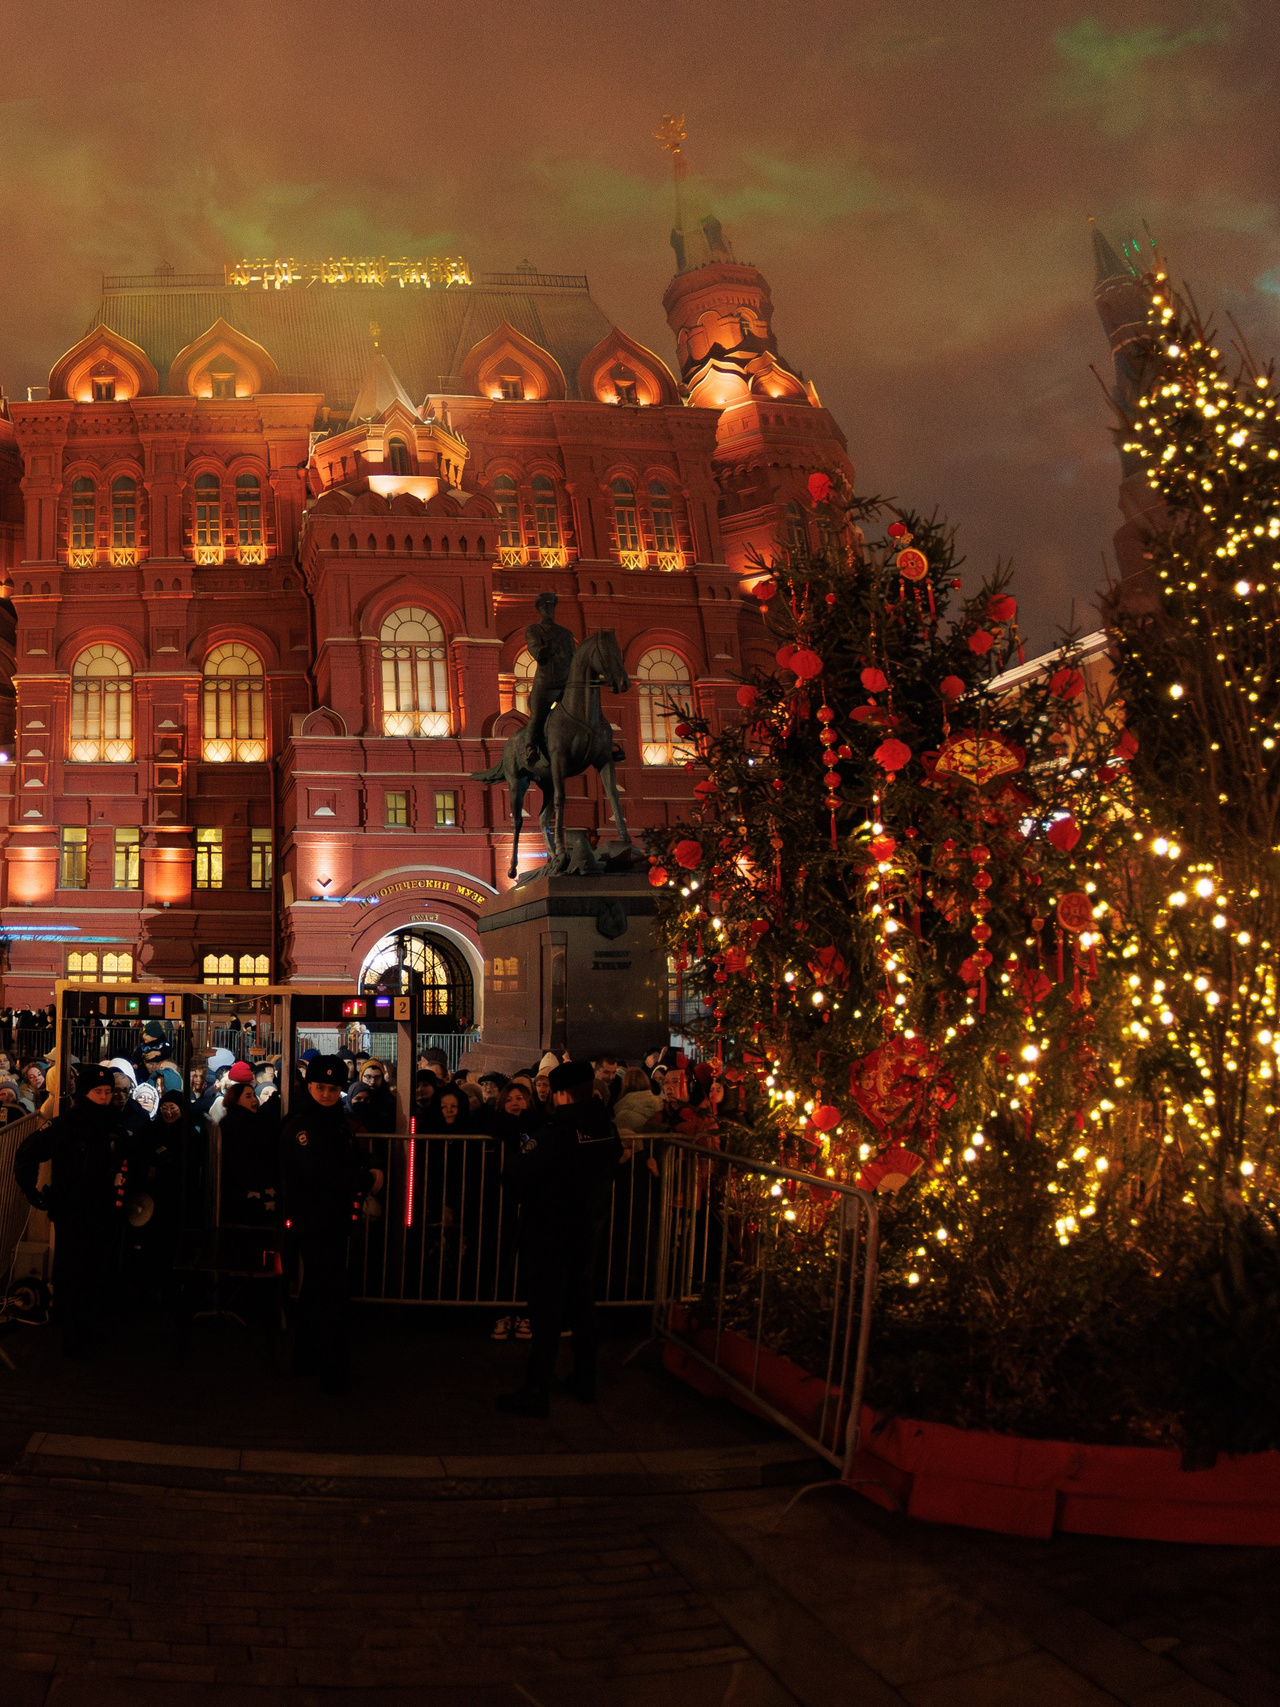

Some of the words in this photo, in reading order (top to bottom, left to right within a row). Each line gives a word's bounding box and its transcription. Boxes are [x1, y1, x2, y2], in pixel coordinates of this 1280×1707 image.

[455, 885, 486, 905] МУЗЕ
[170, 1000, 175, 1013] 1
[399, 1001, 407, 1013] 2
